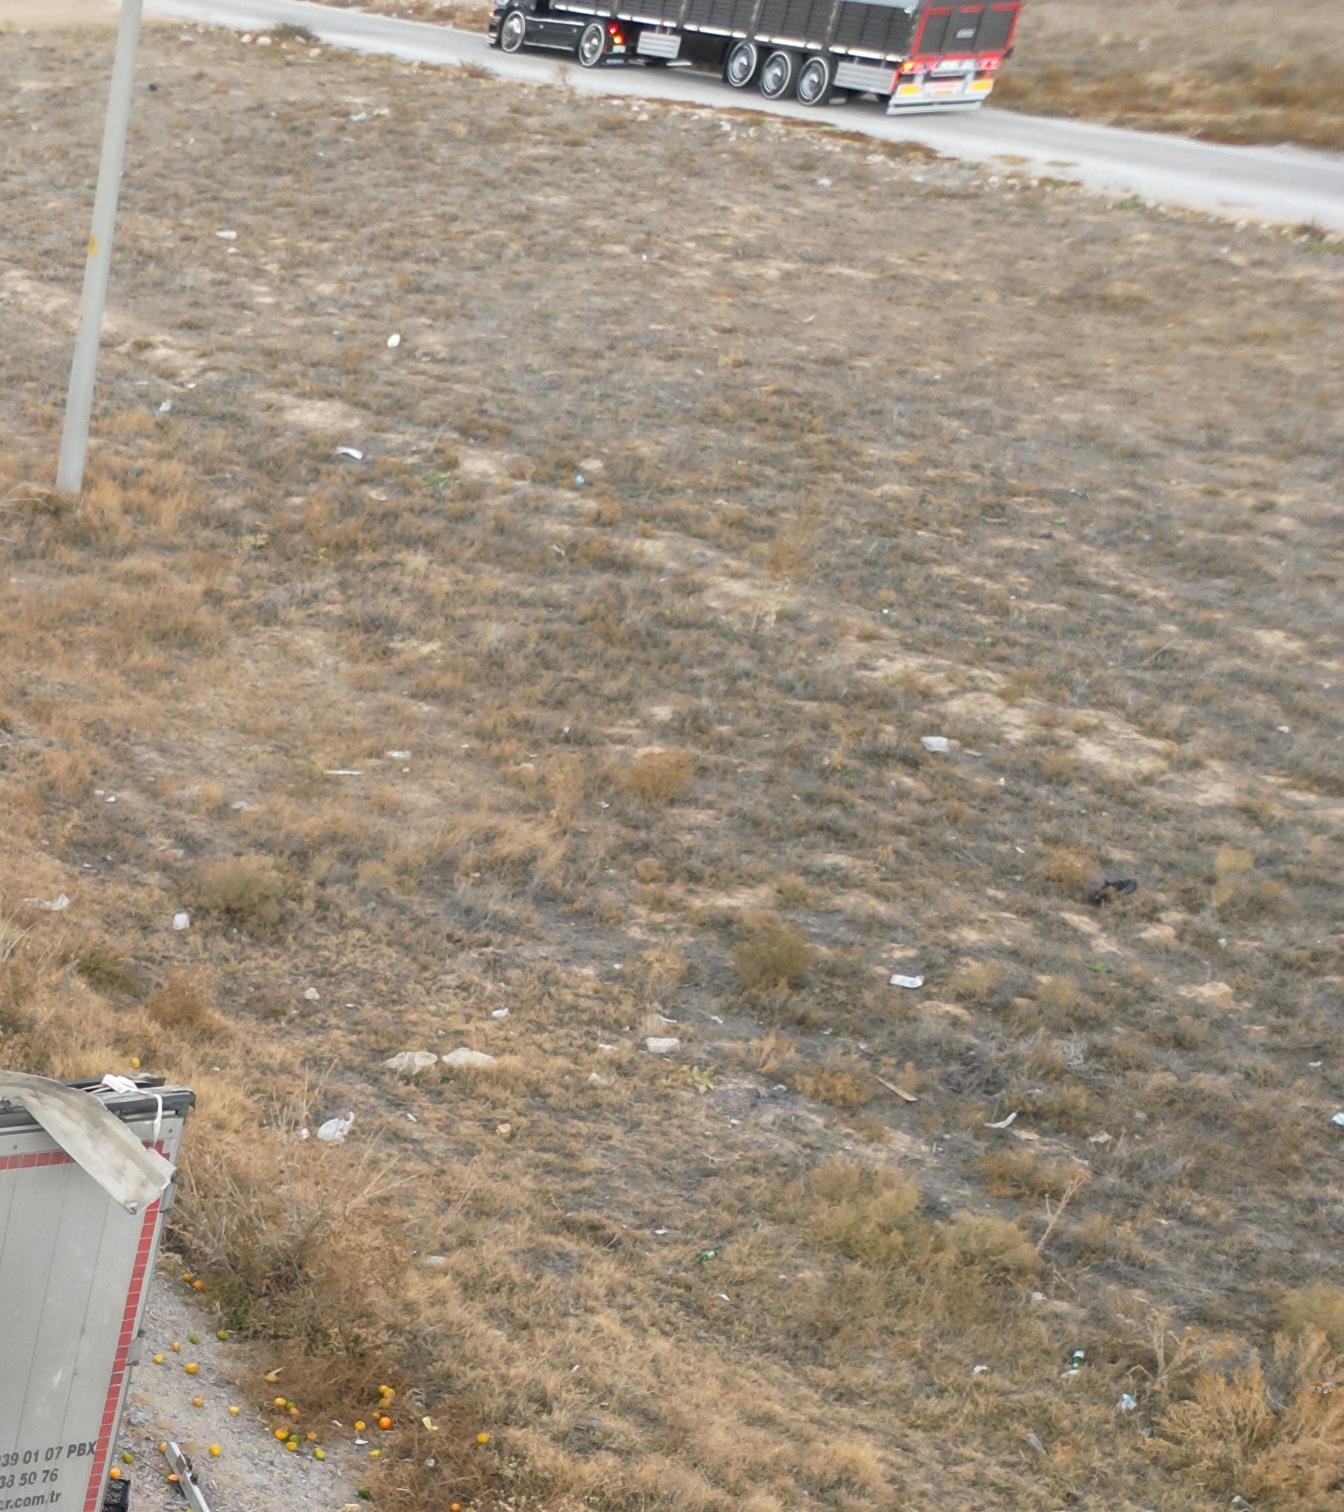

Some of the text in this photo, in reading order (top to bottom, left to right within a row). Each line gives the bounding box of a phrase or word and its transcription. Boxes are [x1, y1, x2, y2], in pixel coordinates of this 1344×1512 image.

[23, 1450, 39, 1464] 01
[45, 1446, 63, 1461] 07
[67, 1440, 97, 1458] PBX
[42, 1468, 59, 1483] 76
